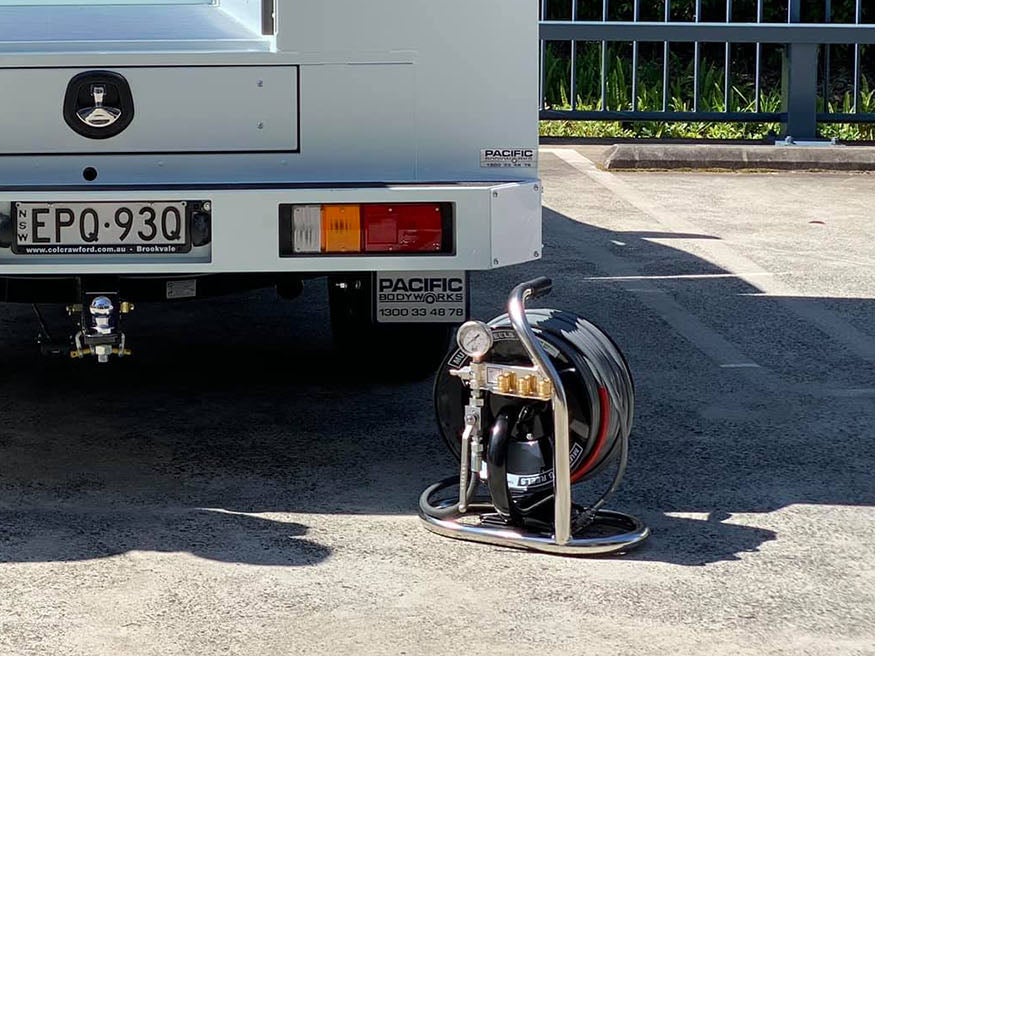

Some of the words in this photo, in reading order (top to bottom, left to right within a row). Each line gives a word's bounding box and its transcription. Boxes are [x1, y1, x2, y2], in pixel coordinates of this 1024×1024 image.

[484, 149, 533, 157] PACIFIC
[26, 246, 126, 254] www.colcrawford.com.au
[136, 245, 176, 253] Brookvale
[379, 278, 463, 292] PACIFIC
[379, 292, 463, 304] BODYWORKS
[379, 308, 409, 317] 1300
[411, 308, 427, 317] 33
[429, 308, 446, 317] 48
[448, 308, 464, 317] 78
